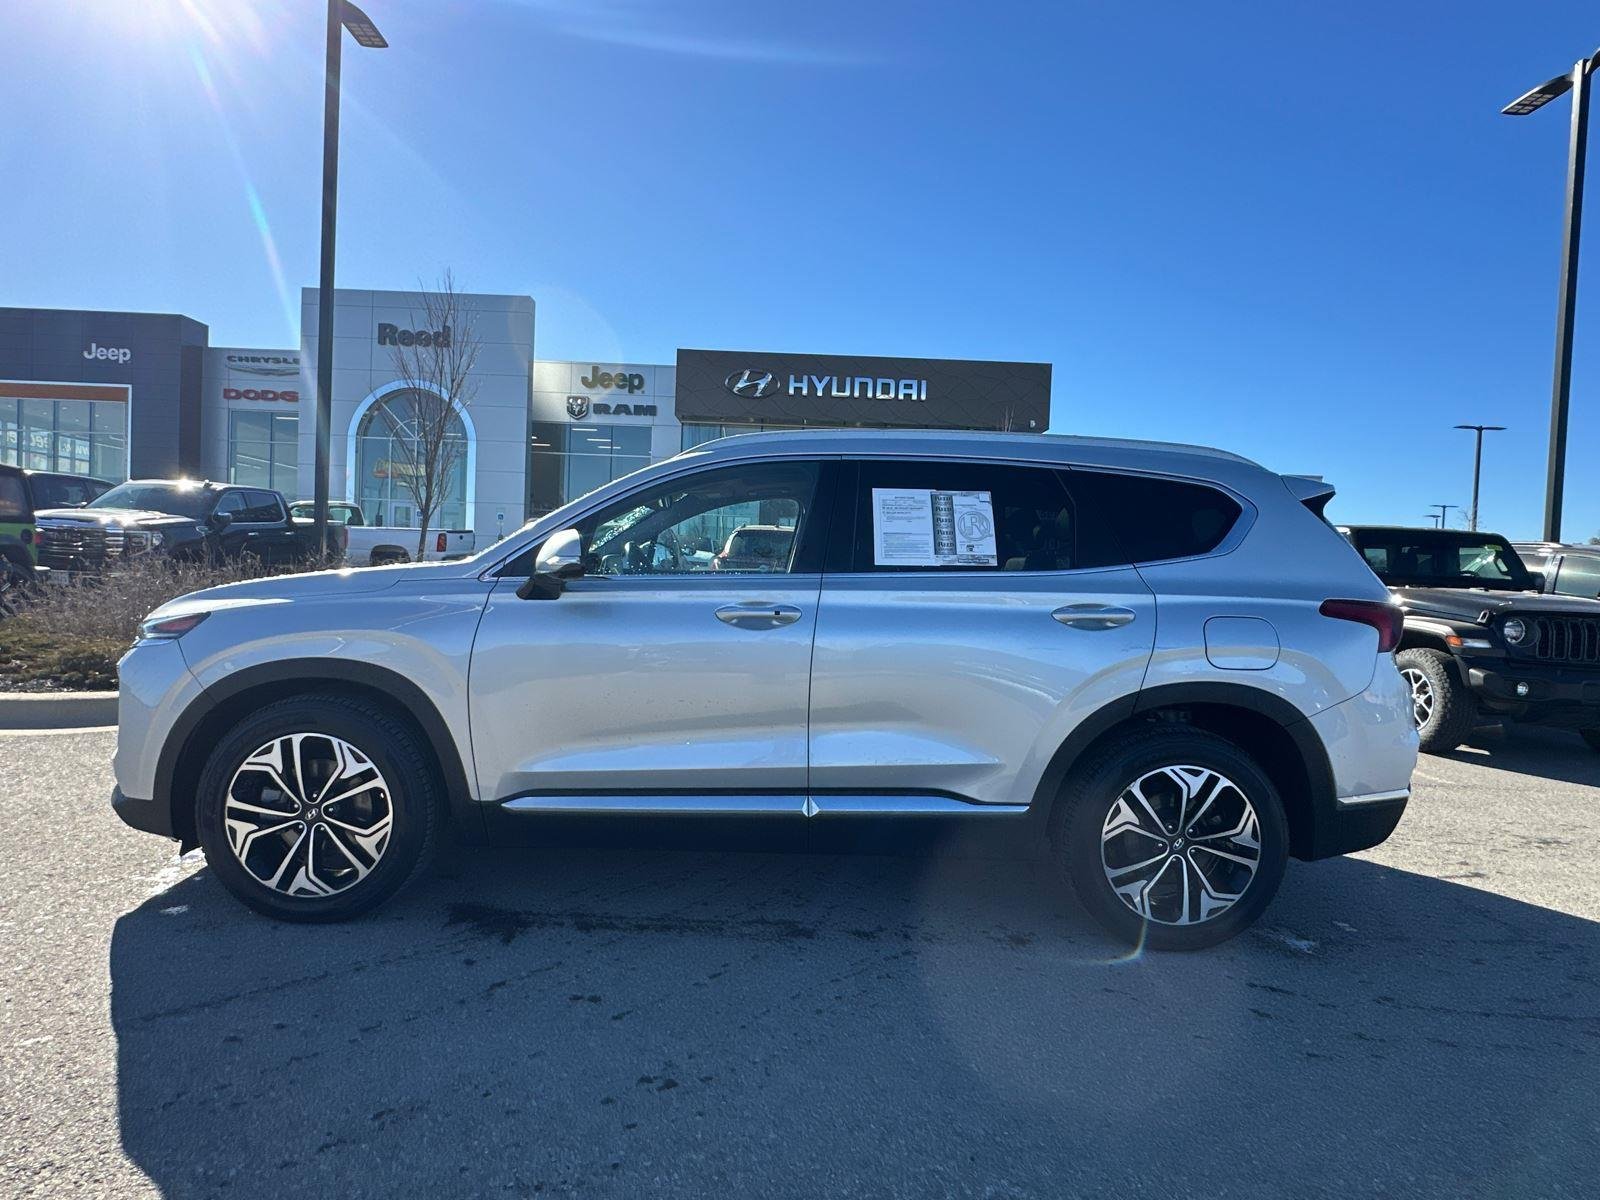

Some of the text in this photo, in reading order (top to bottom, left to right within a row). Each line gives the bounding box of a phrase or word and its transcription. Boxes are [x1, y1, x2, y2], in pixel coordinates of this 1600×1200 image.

[378, 323, 451, 348] Reed
[83, 342, 131, 364] Jeep
[227, 355, 300, 365] CHRYSLE
[581, 365, 645, 394] Jeep
[788, 375, 927, 401] HYUNDAI
[223, 388, 299, 402] DODG
[593, 403, 657, 416] RAM
